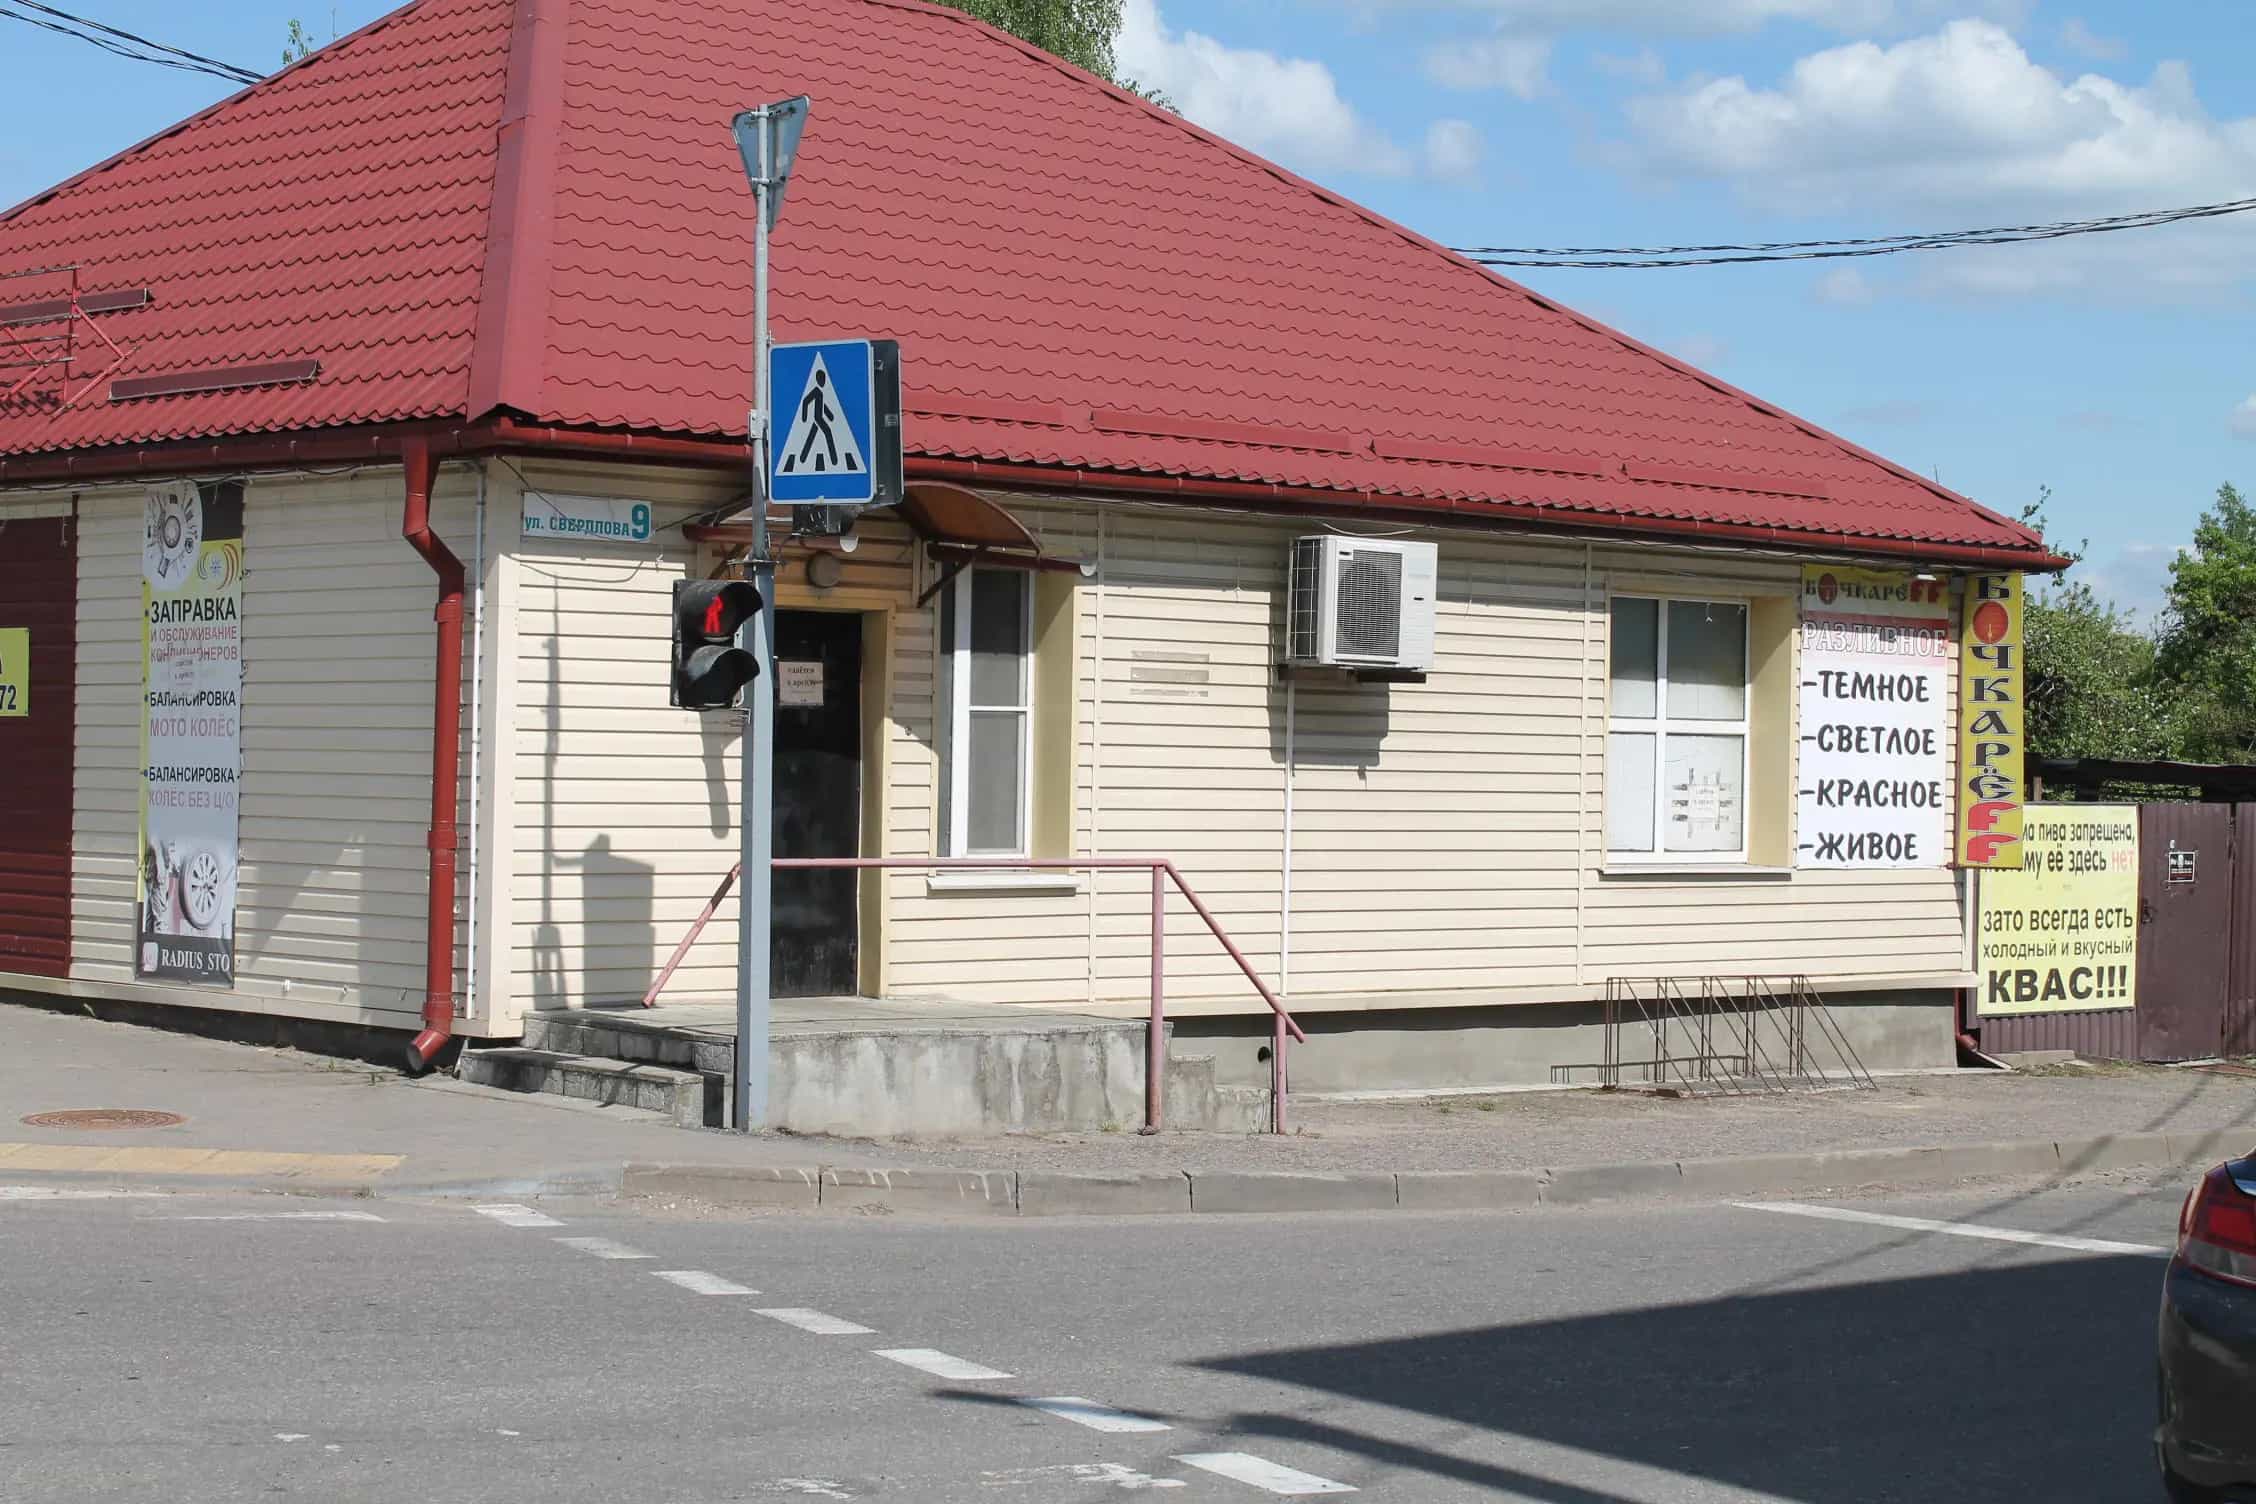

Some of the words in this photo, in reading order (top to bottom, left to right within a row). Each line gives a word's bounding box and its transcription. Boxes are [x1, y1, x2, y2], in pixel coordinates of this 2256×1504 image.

[525, 517, 544, 531] ул.
[549, 516, 630, 536] СВЕРДЛОВА
[631, 503, 650, 539] 9
[151, 597, 237, 623] ЗАПРАВКА
[151, 628, 157, 641] И
[160, 626, 237, 642] ОБСЛУЖИВАНИЕ
[1801, 620, 1947, 657] РАЗЛИВНОЕ
[150, 690, 236, 707] БАЛАНСИРОВКА
[150, 718, 186, 737] МОТО
[191, 714, 235, 737] КОЛЁС
[149, 766, 235, 783] БАЛАНСИРОВКА
[189, 791, 210, 808] БЕЗ
[2038, 823, 2066, 841] пива
[2070, 823, 2135, 846] запрещена,
[2047, 843, 2064, 872] её
[2068, 849, 2107, 876] здесь
[2111, 848, 2135, 872] нет
[1983, 909, 2024, 932] зато
[2029, 907, 2089, 934] всегда
[2095, 907, 2133, 928] есть
[1983, 938, 2057, 960] холодный
[2061, 942, 2069, 956] и
[2073, 935, 2133, 959] вкусный
[1988, 965, 2128, 1003] КВАС!!!
